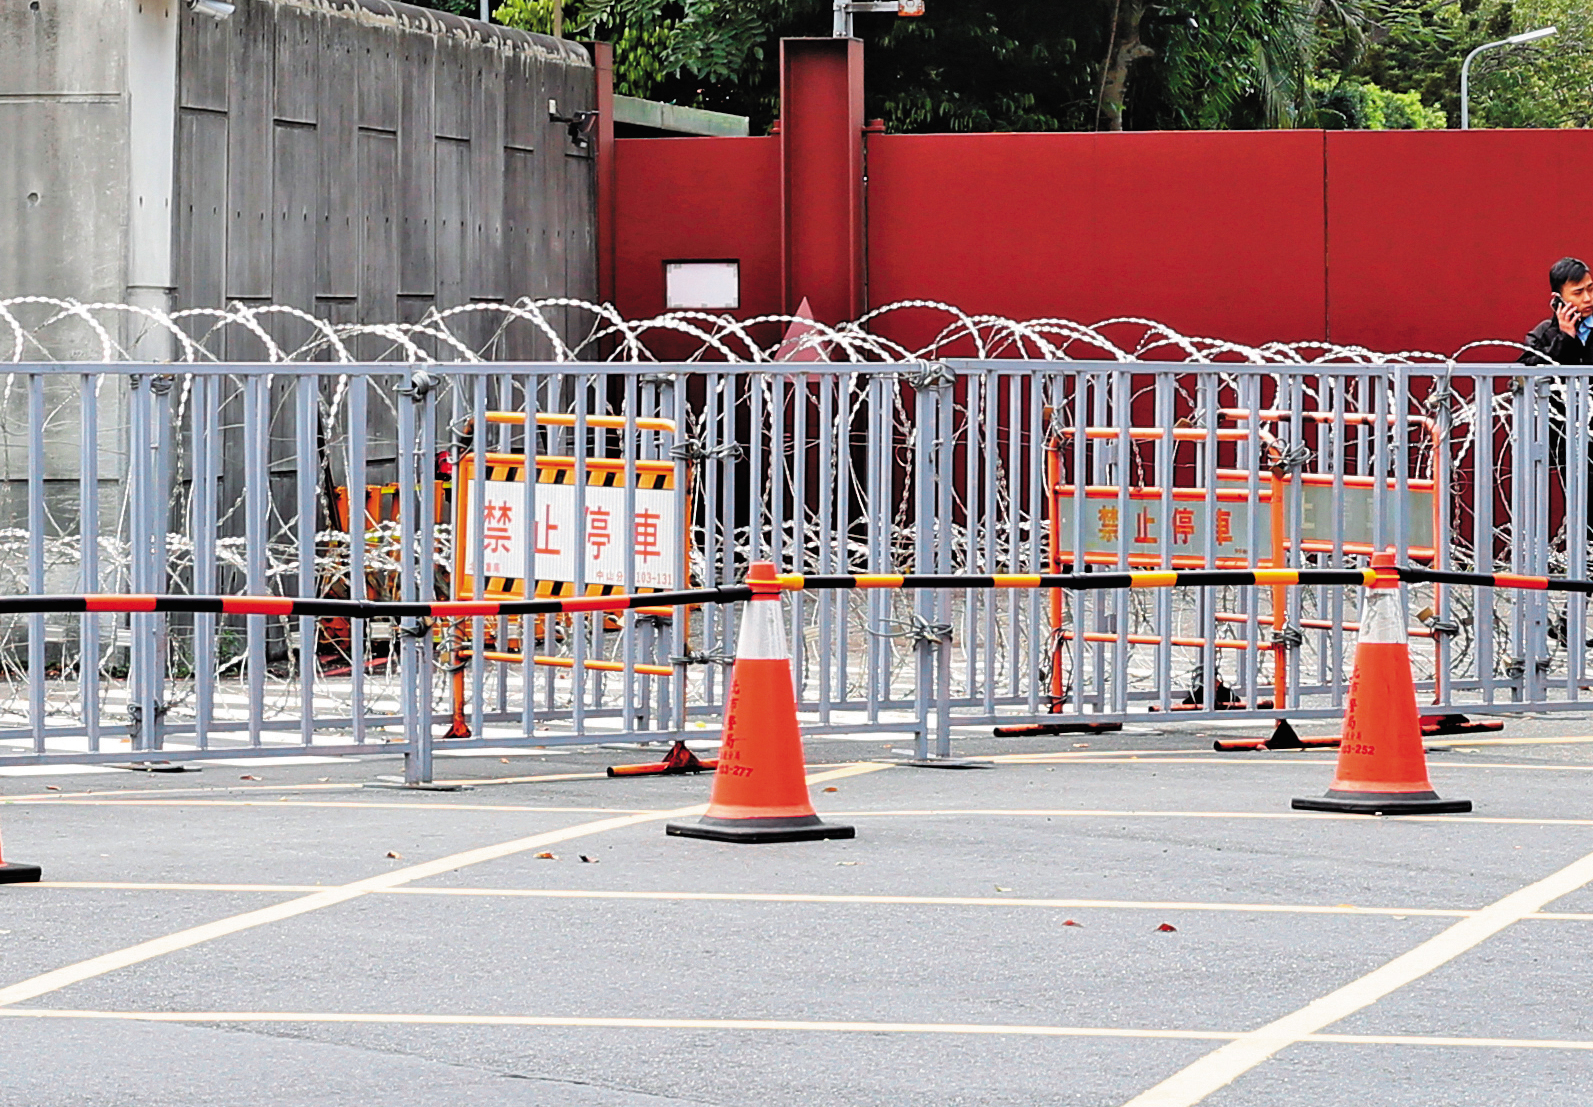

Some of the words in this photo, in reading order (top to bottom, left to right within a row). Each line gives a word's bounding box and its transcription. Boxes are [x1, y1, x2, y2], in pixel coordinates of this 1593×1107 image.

[482, 499, 661, 564] 禁止停車
[1098, 505, 1233, 546] 禁止停車
